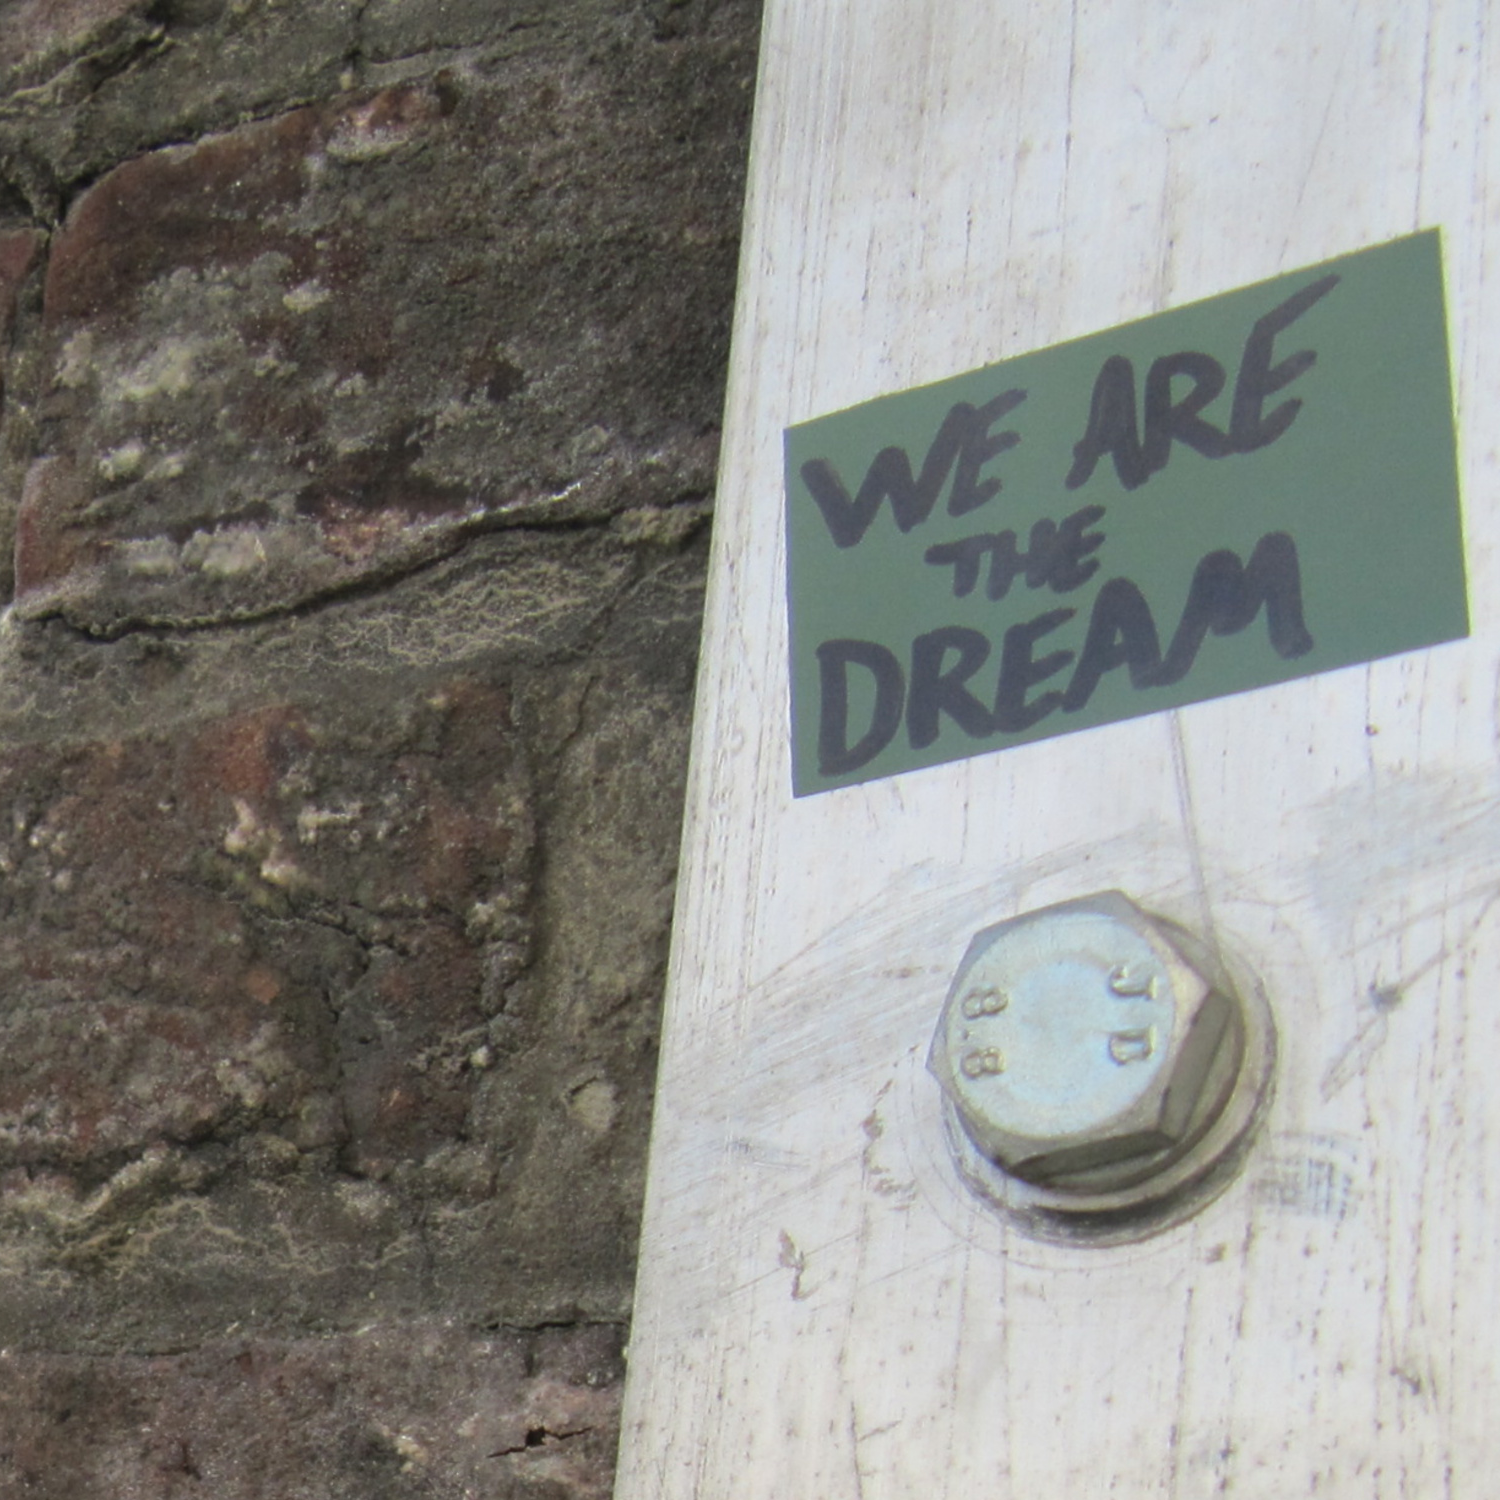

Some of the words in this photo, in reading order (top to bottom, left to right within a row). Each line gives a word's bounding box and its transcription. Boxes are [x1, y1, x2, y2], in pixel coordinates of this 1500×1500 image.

[800, 388, 1028, 549] WE
[1066, 274, 1341, 490] ARE
[815, 532, 1314, 776] DREAM
[924, 504, 1106, 600] THE
